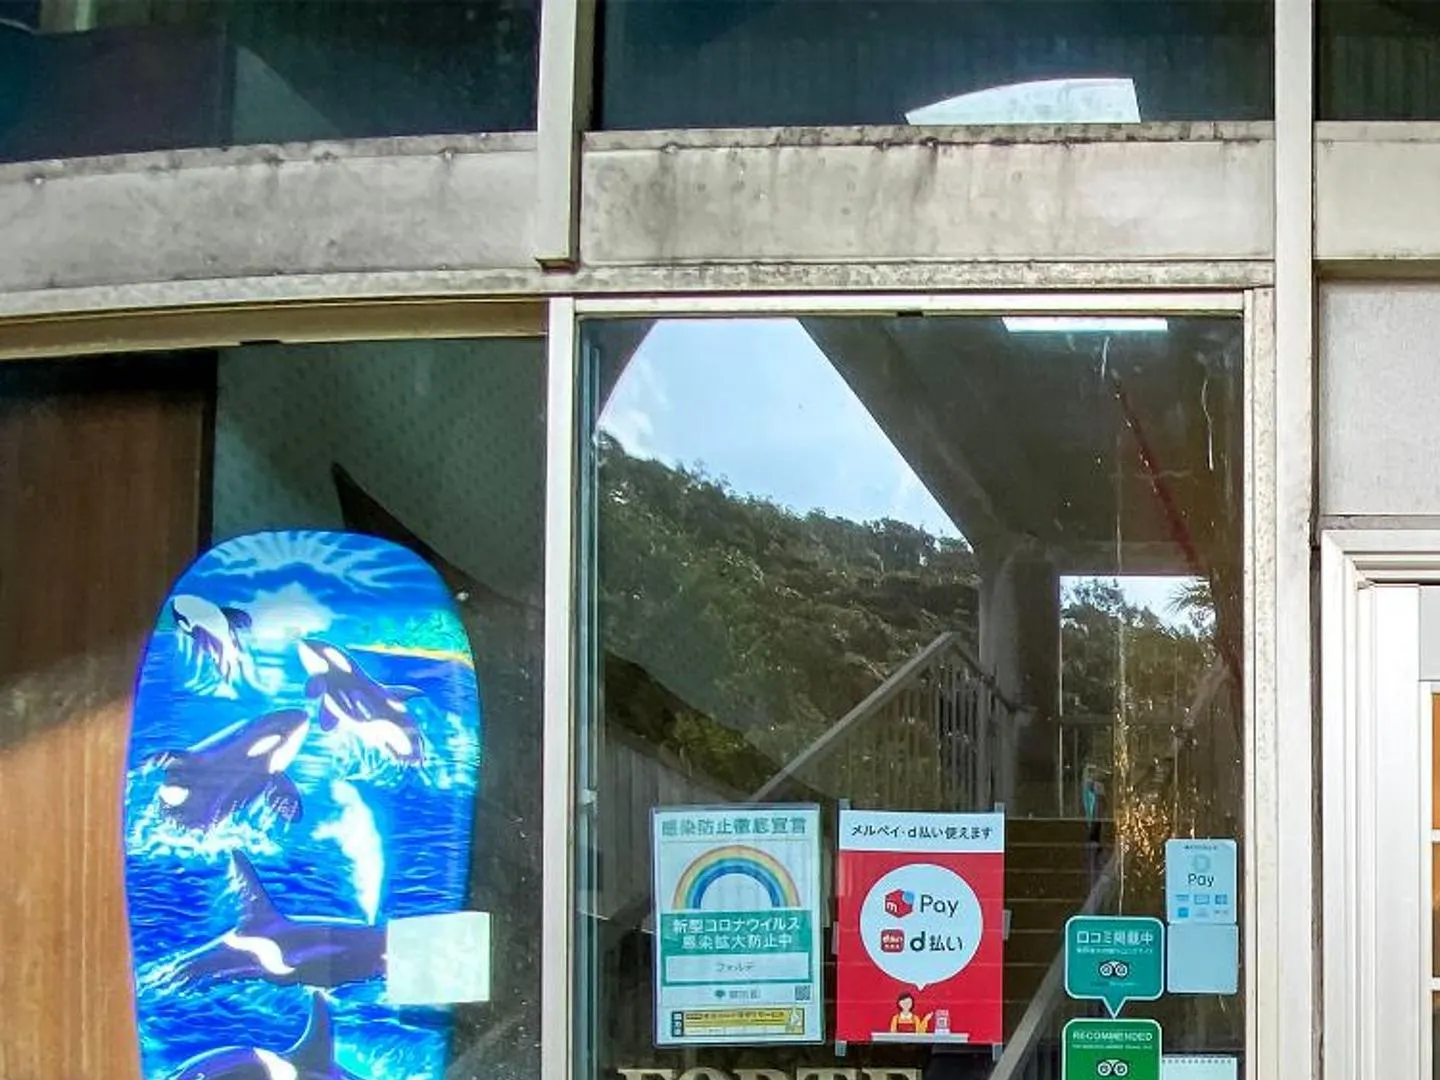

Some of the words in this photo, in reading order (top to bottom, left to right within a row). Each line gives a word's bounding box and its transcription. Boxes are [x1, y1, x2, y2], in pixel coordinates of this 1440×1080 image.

[1187, 872, 1215, 888] Pay
[919, 894, 959, 918] Pay
[672, 917, 800, 934] 新型コロナウイルス
[681, 934, 793, 950] 感染拡大防止中
[909, 931, 963, 952] d払い
[1072, 1031, 1153, 1041] RECOMMENDED
